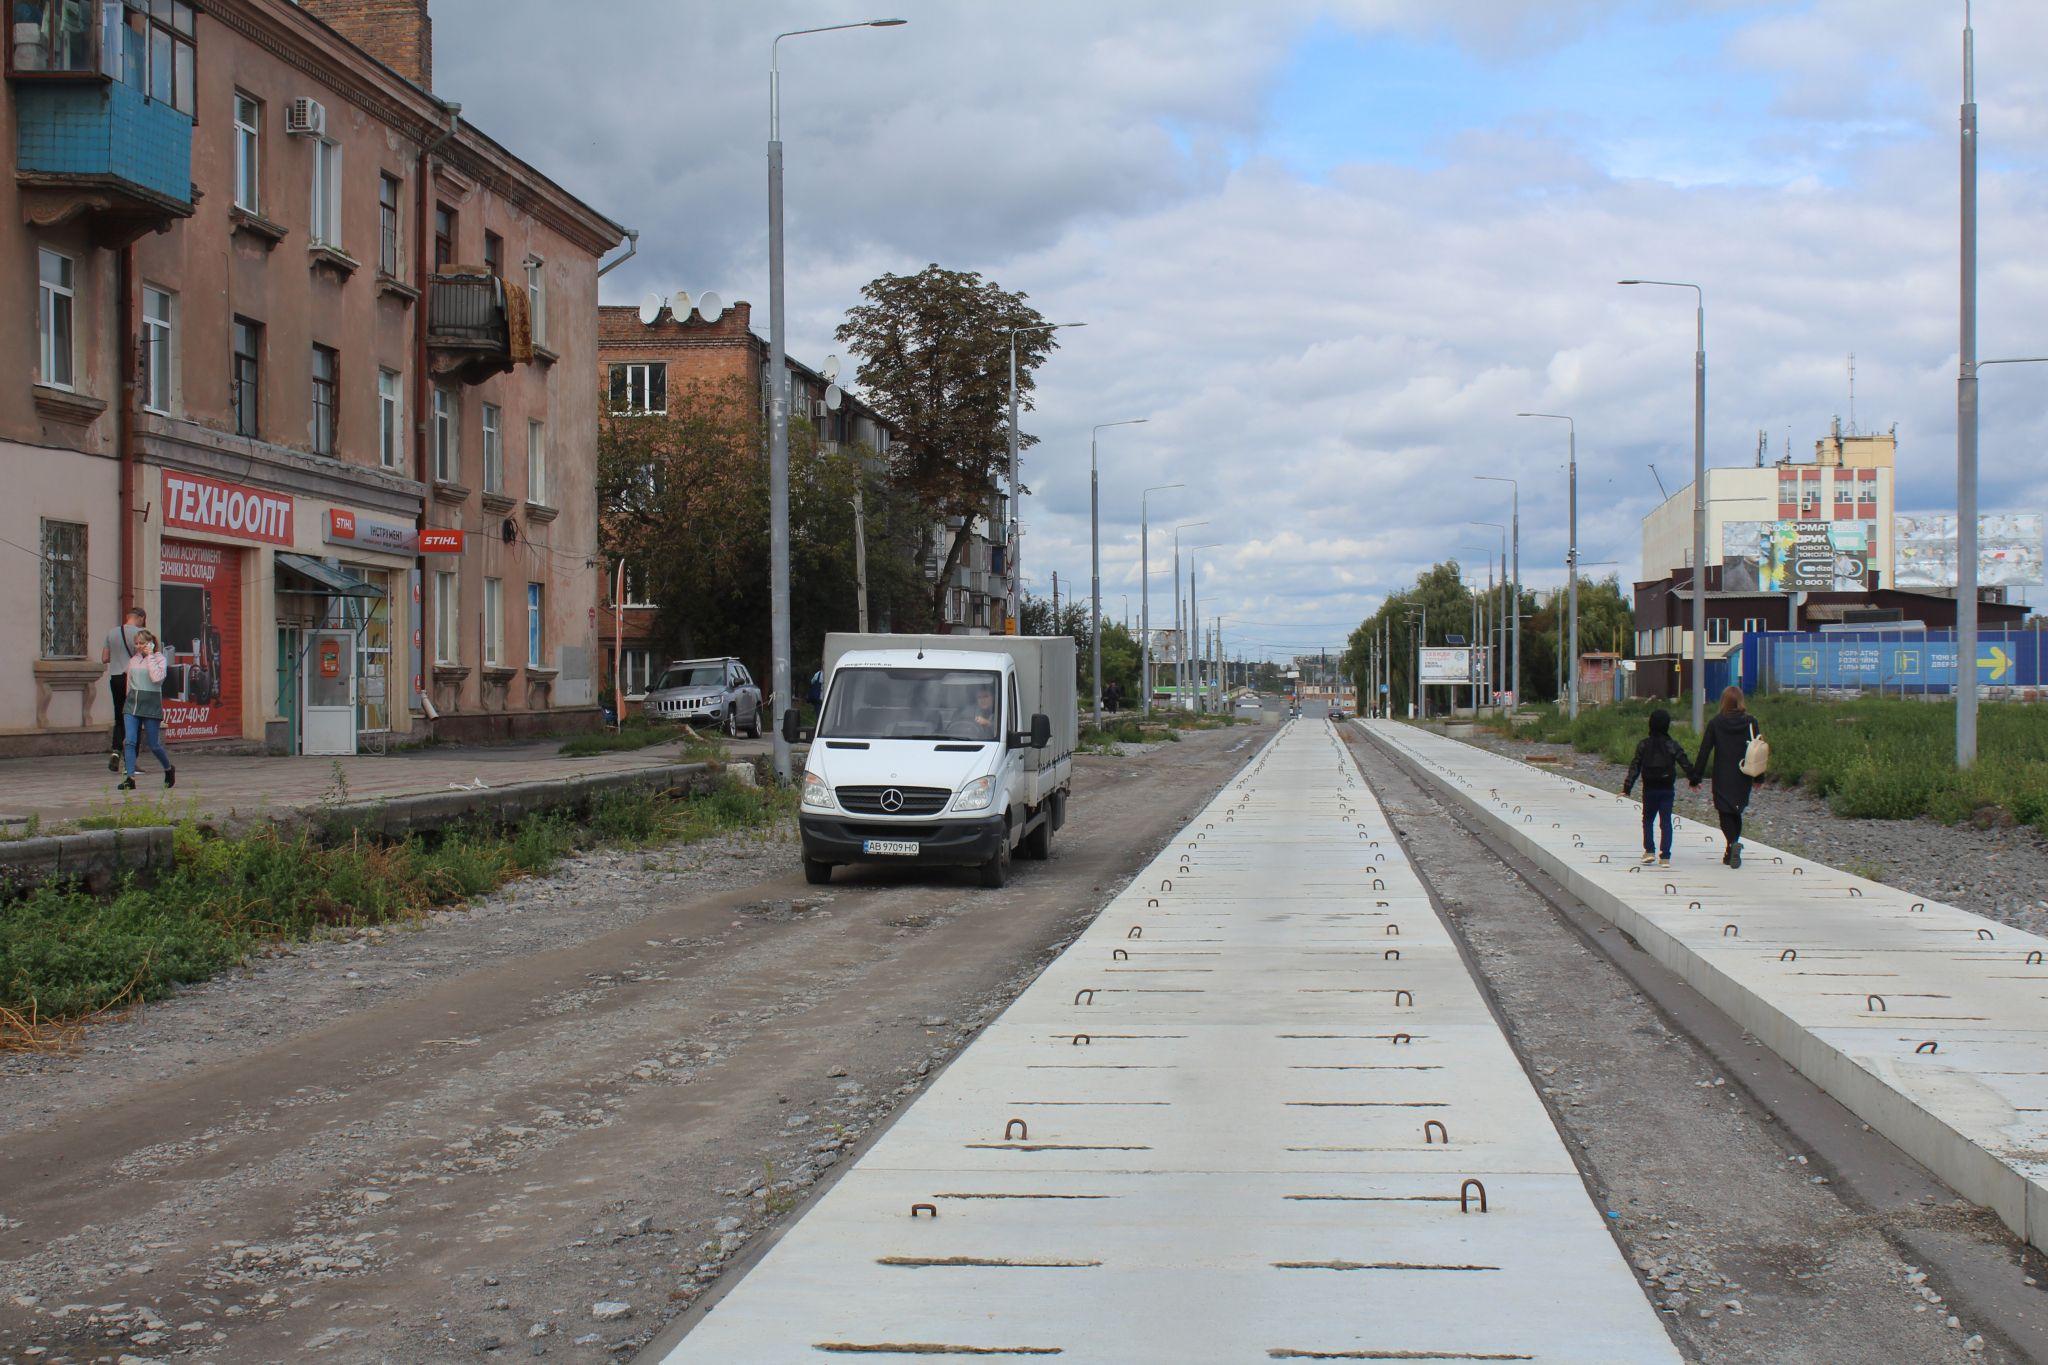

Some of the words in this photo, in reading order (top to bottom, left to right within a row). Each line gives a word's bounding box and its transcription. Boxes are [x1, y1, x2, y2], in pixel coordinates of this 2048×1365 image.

[168, 478, 290, 538] ТЕХНООПТ
[336, 517, 353, 531] STIHL
[424, 536, 458, 546] STIHL
[161, 543, 180, 560] ОКИЙ
[181, 546, 222, 564] АСОРТИМЕНТ
[160, 560, 184, 577] ЕХНІКИ
[184, 563, 190, 577] ЗІ
[191, 564, 216, 583] СКЛАДУ
[883, 843, 903, 852] 9709
